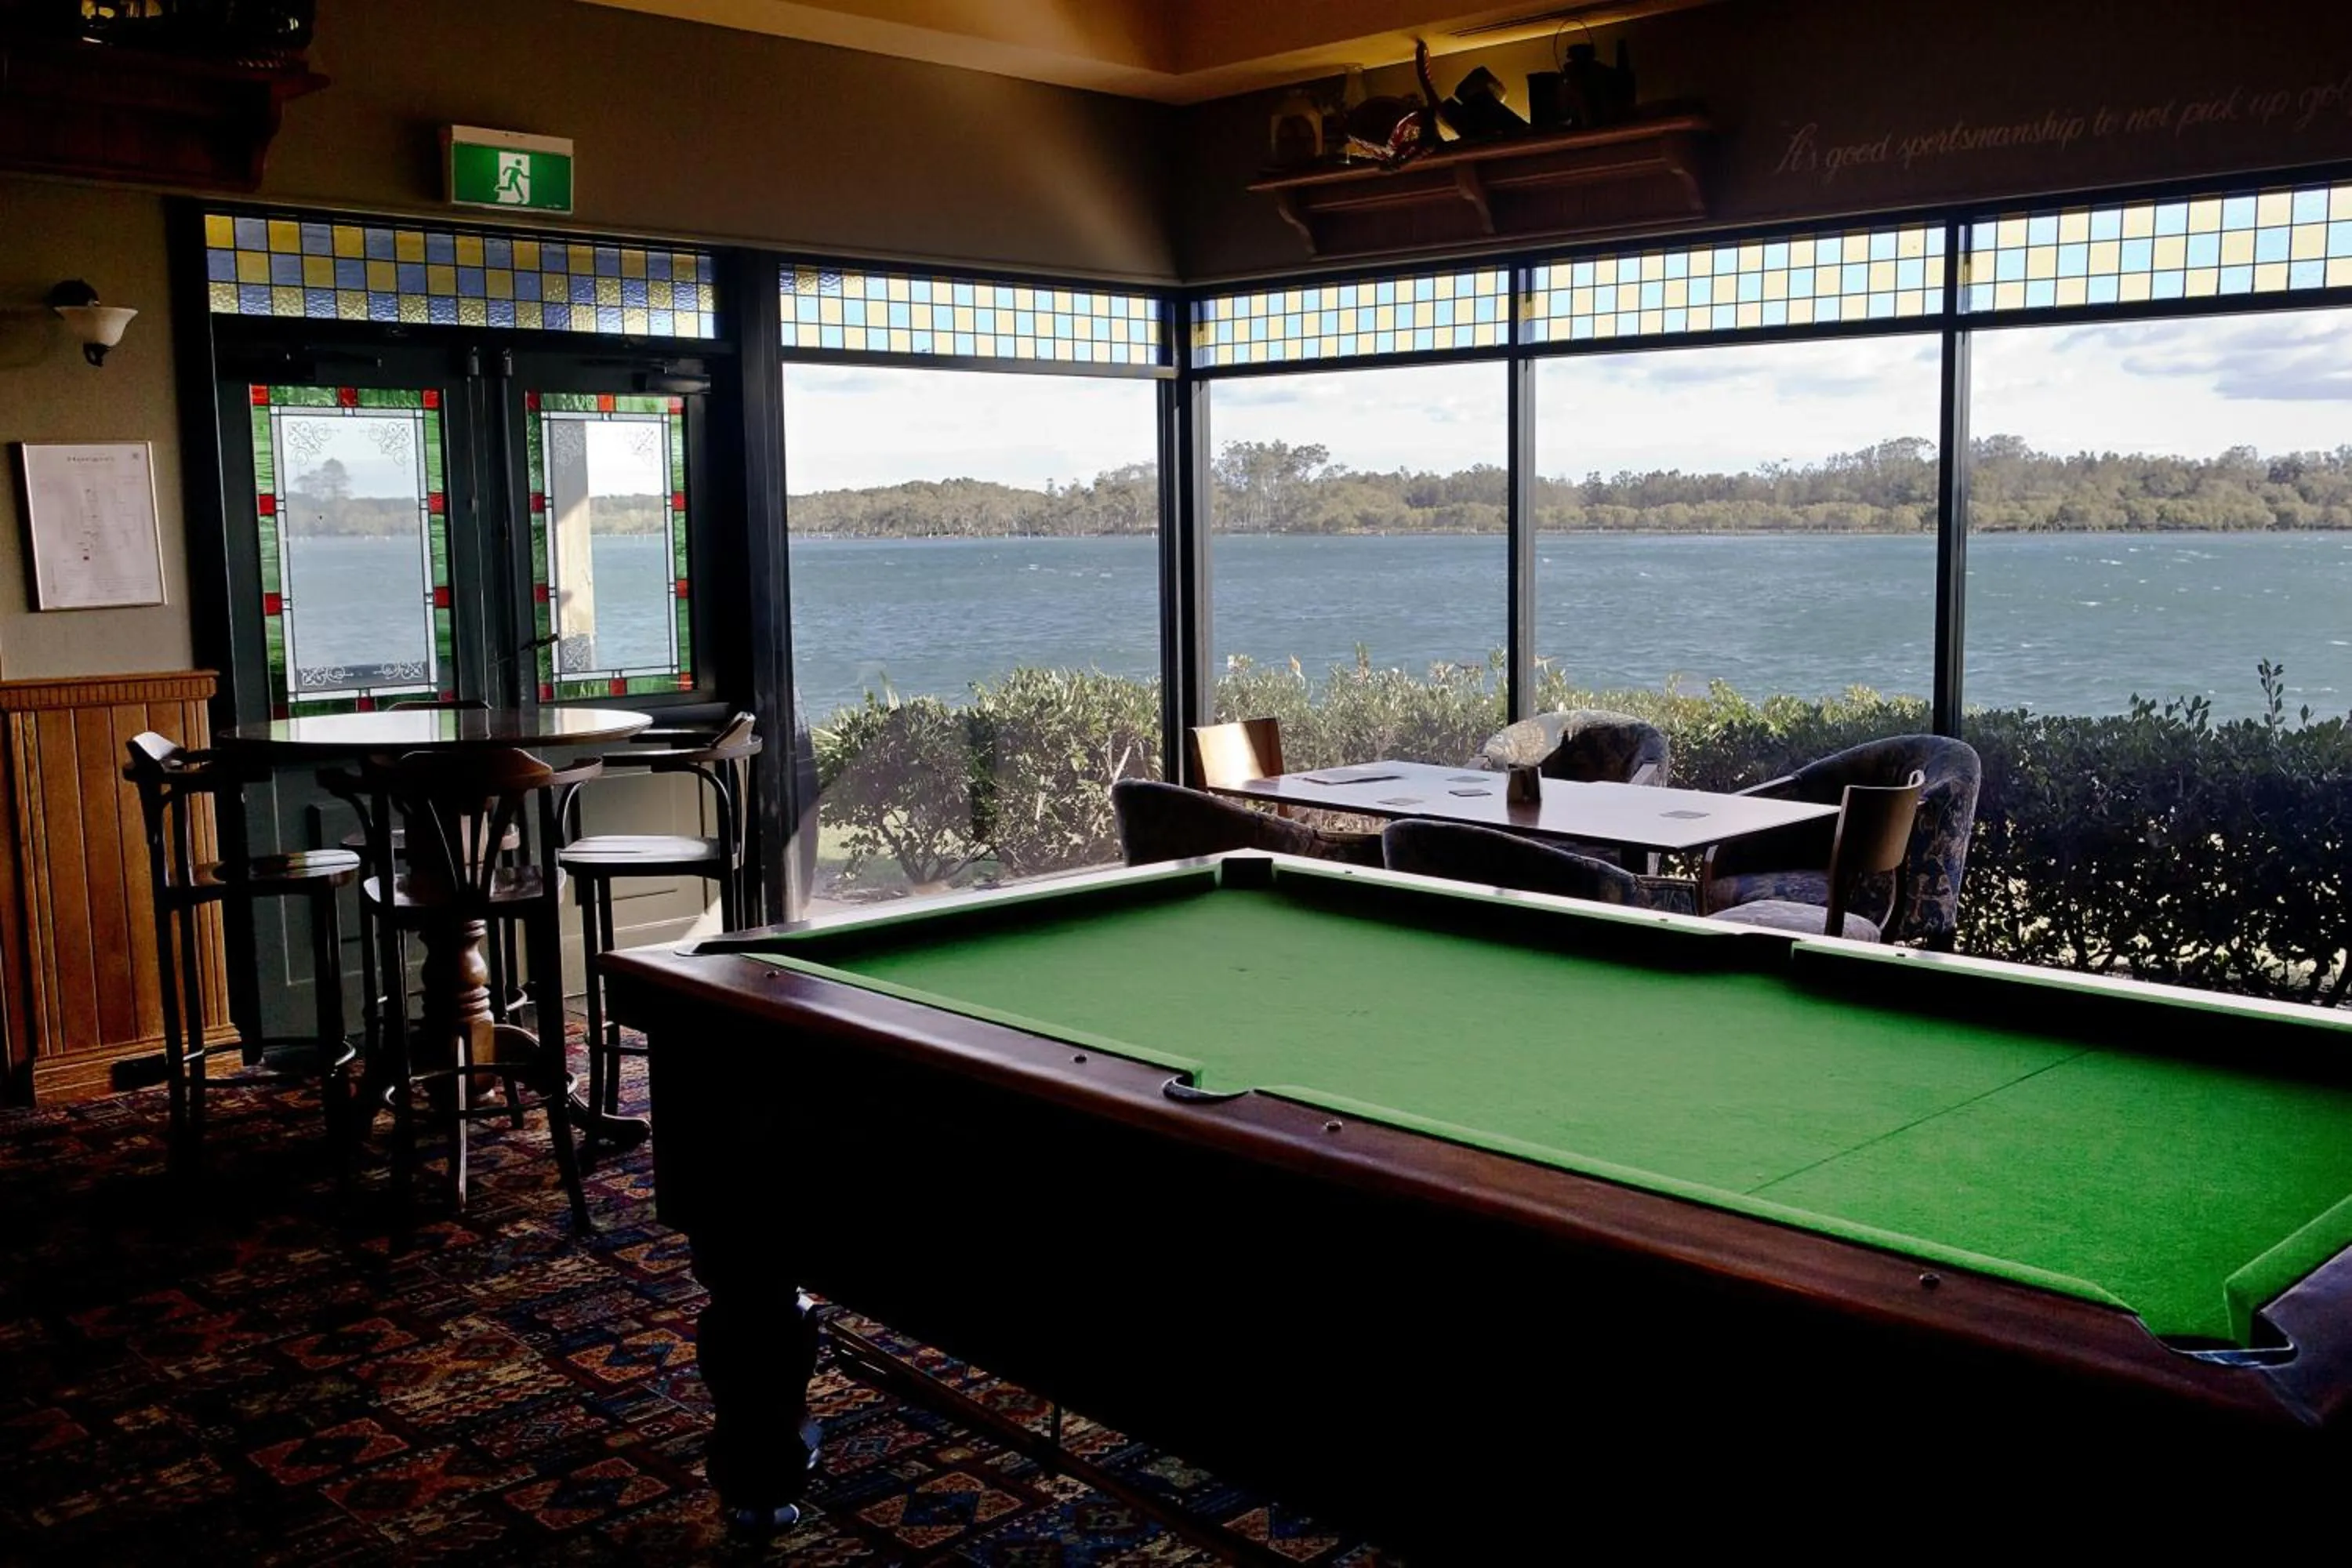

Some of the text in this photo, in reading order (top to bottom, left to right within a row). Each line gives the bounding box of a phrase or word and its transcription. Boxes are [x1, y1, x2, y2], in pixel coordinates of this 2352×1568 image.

[1825, 129, 1893, 183] good
[1896, 108, 2085, 170] sportsmanship
[2092, 103, 2118, 137] to
[2124, 98, 2176, 133] not
[2175, 84, 2245, 139] pick
[2249, 89, 2290, 127] up
[2293, 70, 2352, 132] gol
